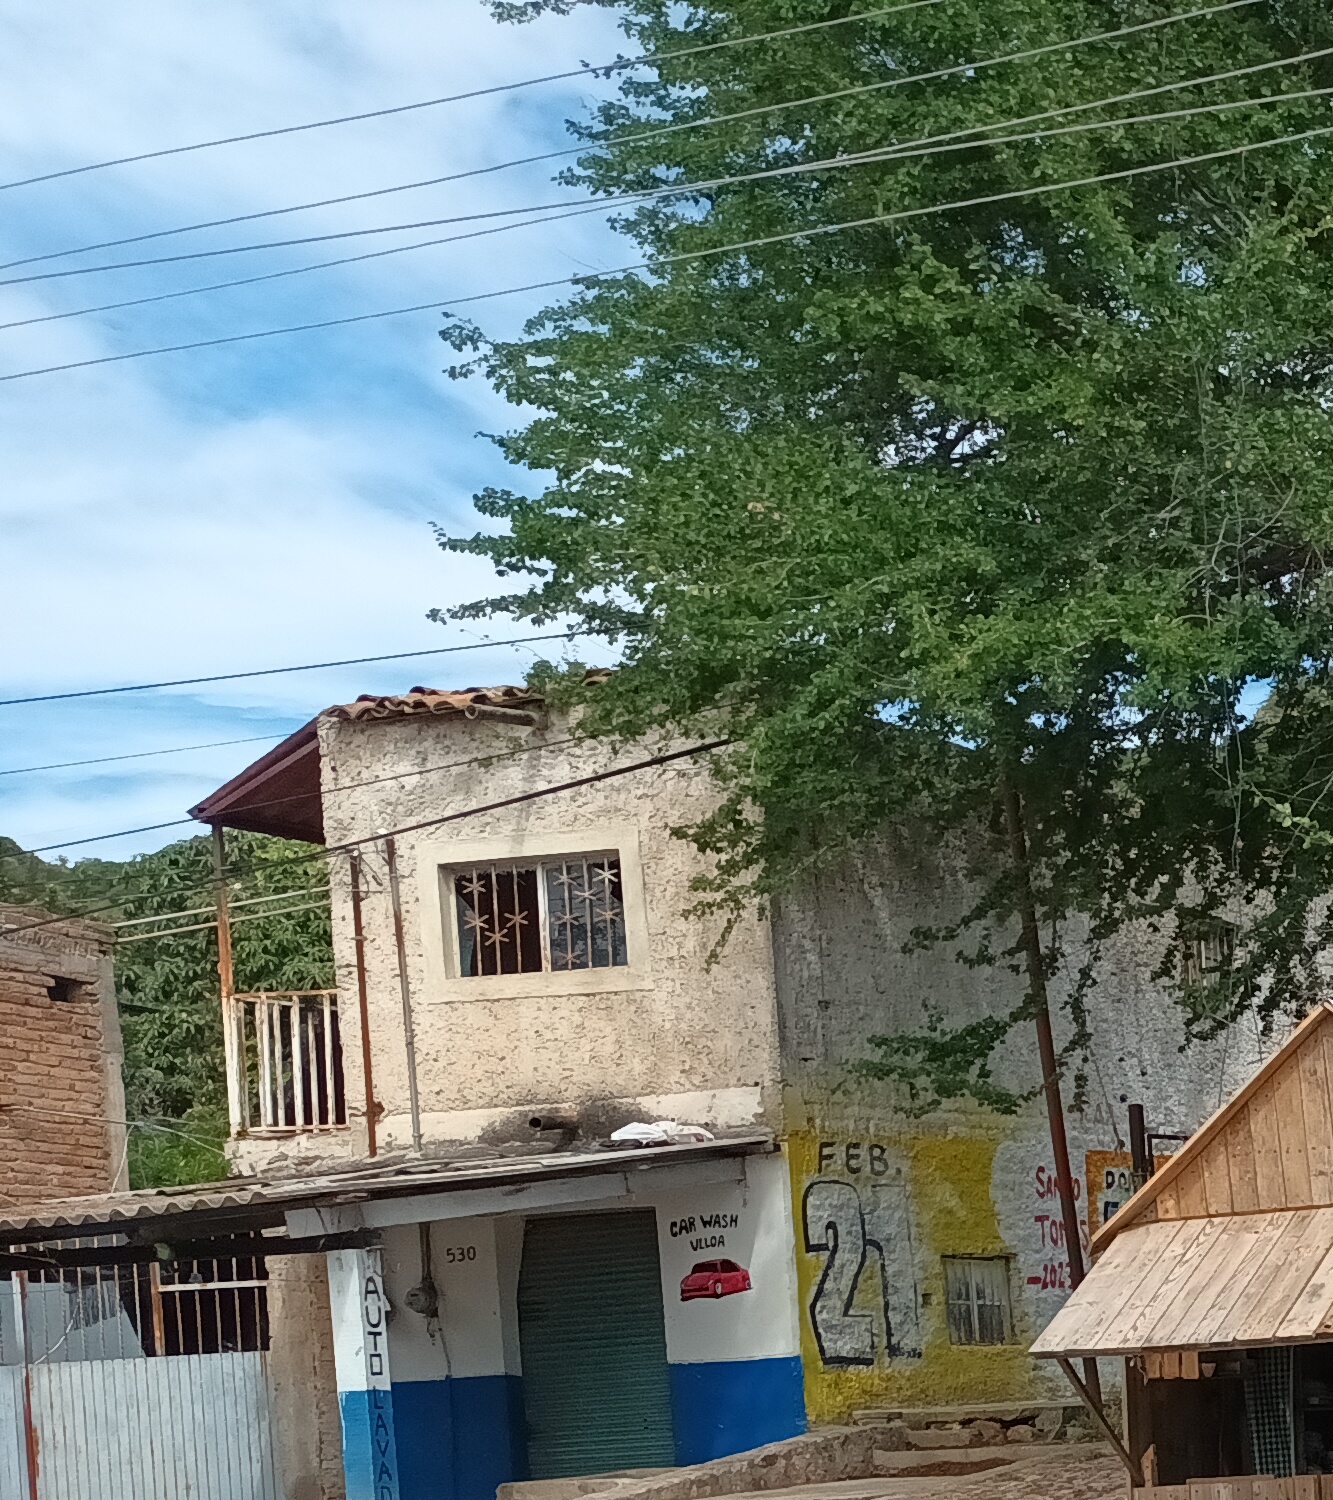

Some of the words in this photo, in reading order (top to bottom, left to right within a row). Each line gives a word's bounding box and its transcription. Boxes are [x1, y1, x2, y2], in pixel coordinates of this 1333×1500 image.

[670, 1216, 696, 1237] CAR
[700, 1213, 739, 1229] WASH
[446, 1246, 476, 1263] 530
[364, 1276, 383, 1376] AUTO
